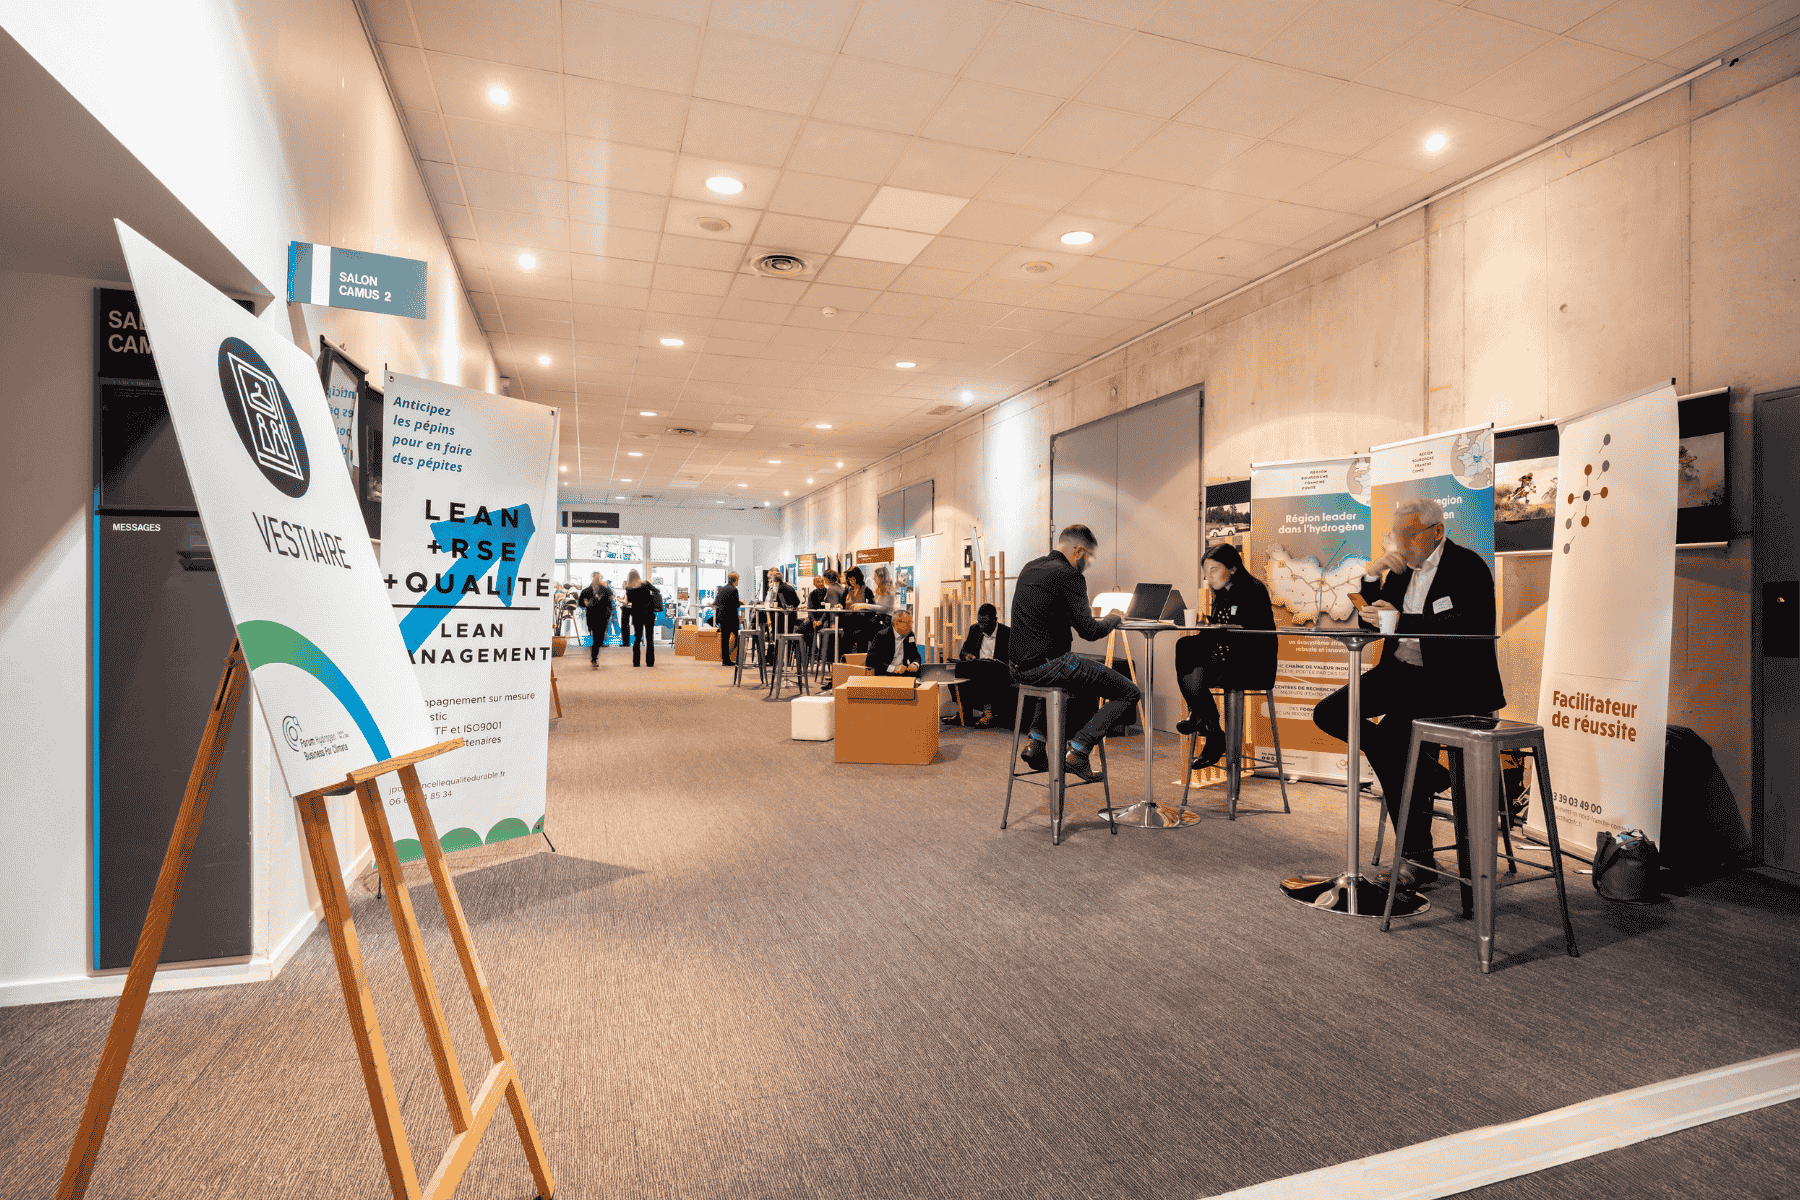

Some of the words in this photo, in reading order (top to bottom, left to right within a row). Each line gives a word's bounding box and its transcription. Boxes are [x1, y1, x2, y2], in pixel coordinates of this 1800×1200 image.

[339, 271, 378, 287] SALON
[338, 285, 380, 300] CAMUS
[384, 291, 392, 302] 2
[107, 310, 146, 331] SAL
[107, 333, 152, 355] CAM
[393, 396, 451, 417] Anticipez
[393, 414, 411, 428] les
[413, 420, 456, 436] pépins
[392, 435, 423, 448] pour
[426, 441, 441, 451] en
[442, 442, 473, 456] faire
[392, 452, 414, 466] des
[416, 457, 463, 473] pépites
[425, 499, 519, 529] LEAN
[1285, 513, 1320, 525] Région
[1322, 511, 1357, 522] leader
[112, 523, 162, 533] MESSAGES
[1278, 525, 1302, 535] dans
[1303, 521, 1366, 535] l'hydrogène
[252, 511, 352, 570] VESTIAIRE
[440, 622, 504, 639] LEAN
[488, 694, 503, 704] sur
[504, 692, 536, 702] mesure
[1552, 689, 1638, 719] Facilitateur
[429, 711, 448, 722] stic
[1551, 710, 1570, 730] de
[1573, 714, 1637, 742] réussite
[450, 724, 461, 734] et
[463, 720, 502, 733] ISO9001
[464, 735, 502, 747] tenaires
[430, 791, 441, 800] 85
[442, 789, 453, 798] 34
[1558, 793, 1568, 804] 39
[1568, 796, 1579, 808] 03
[1579, 799, 1590, 811] 49
[1590, 803, 1603, 815] 00
